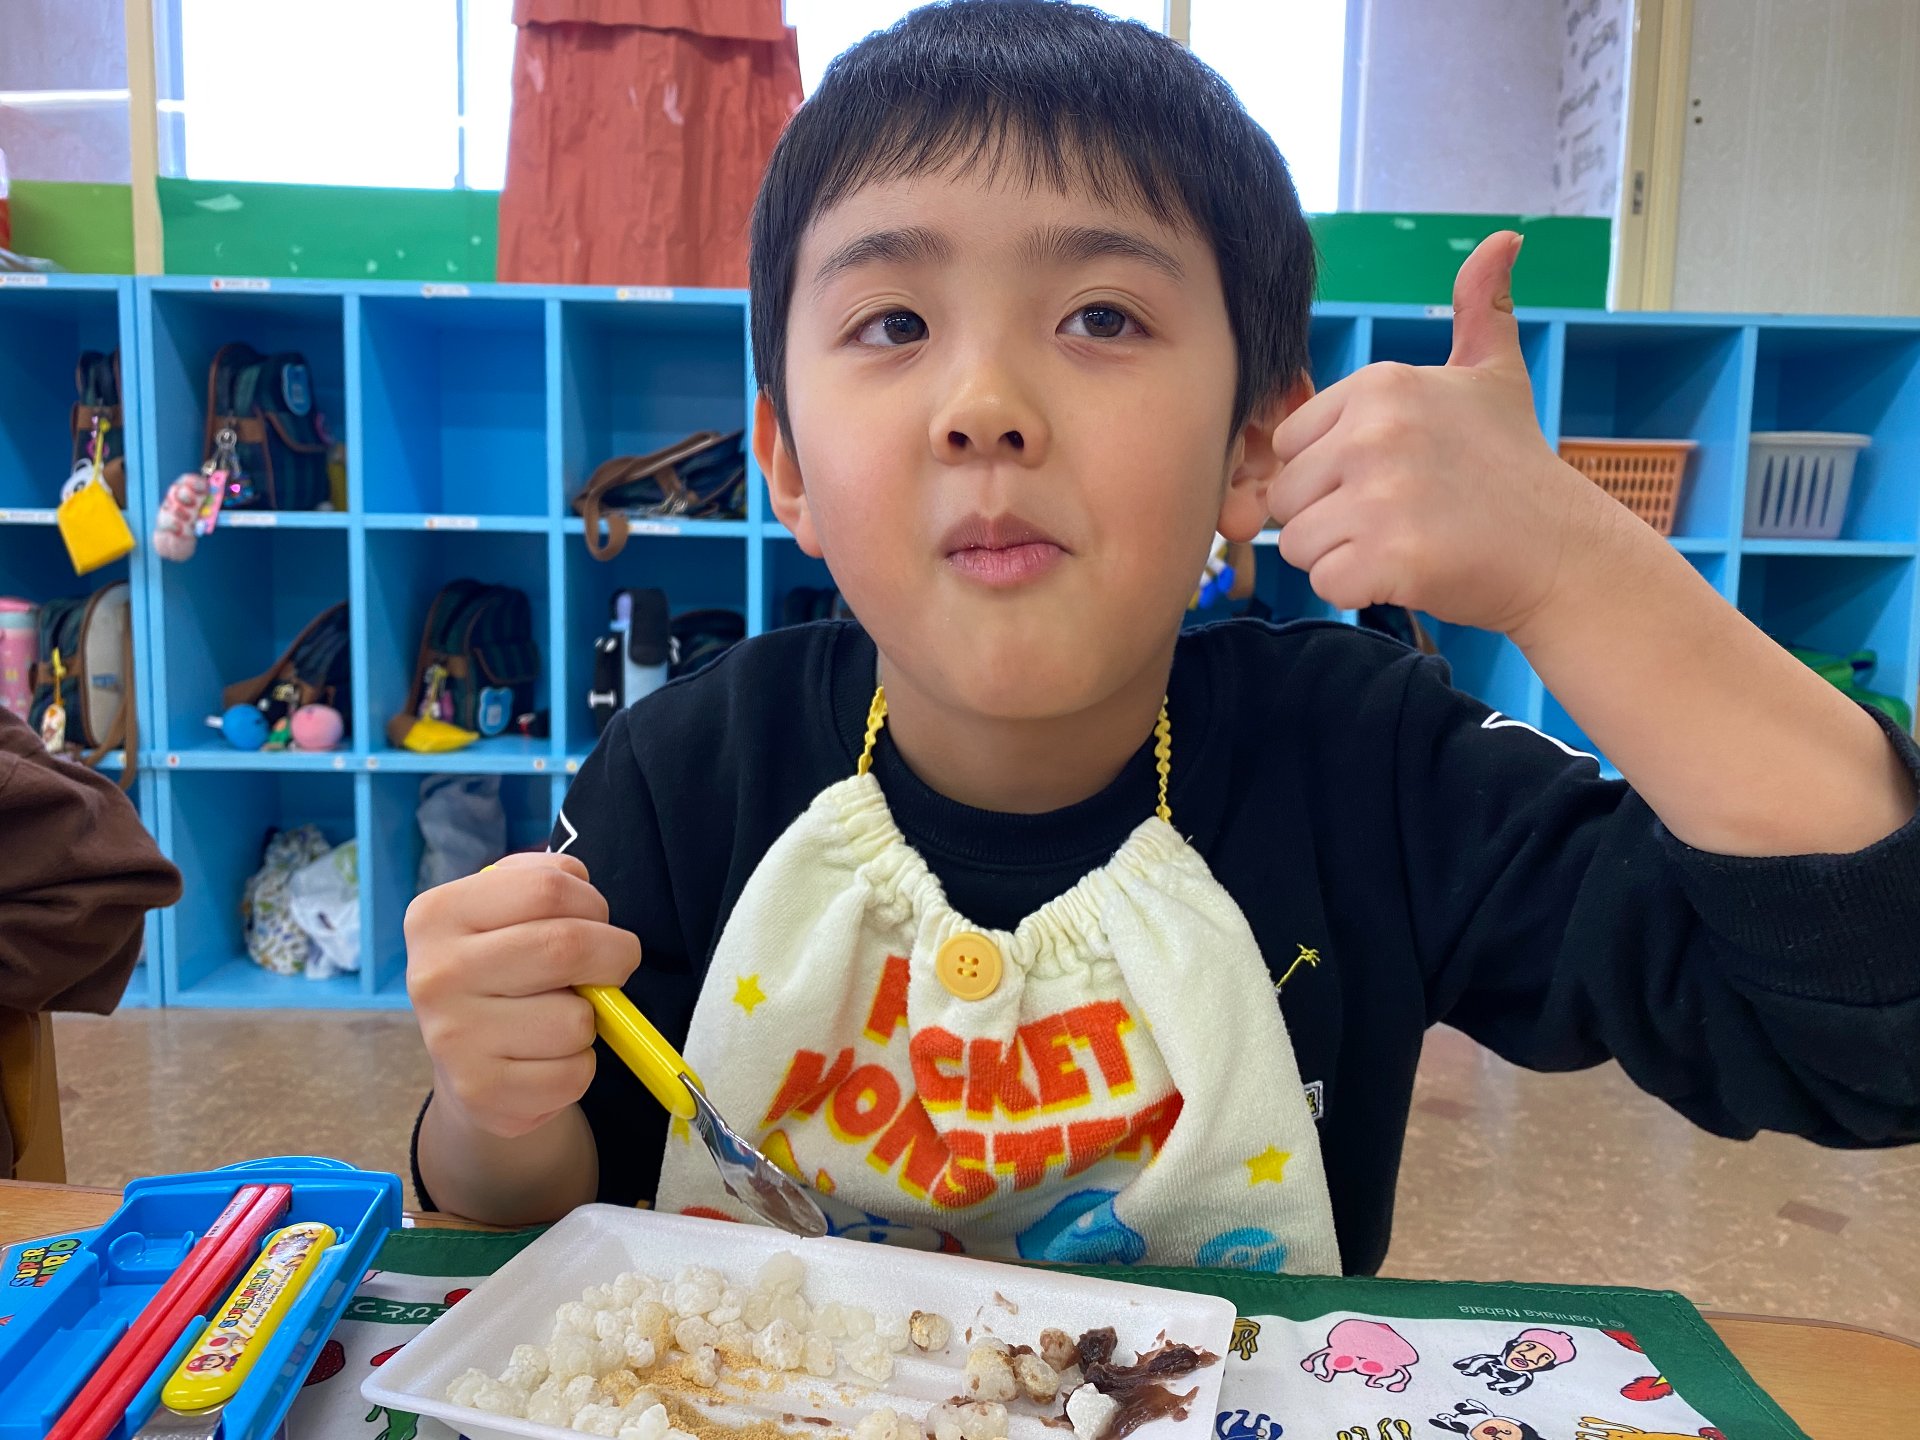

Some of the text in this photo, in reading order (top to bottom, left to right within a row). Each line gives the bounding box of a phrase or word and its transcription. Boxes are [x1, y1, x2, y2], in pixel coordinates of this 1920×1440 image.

[9, 1247, 48, 1287] SUPER
[218, 1268, 275, 1328] SUPER MARIO
[1458, 1305, 1521, 1318] Nabata
